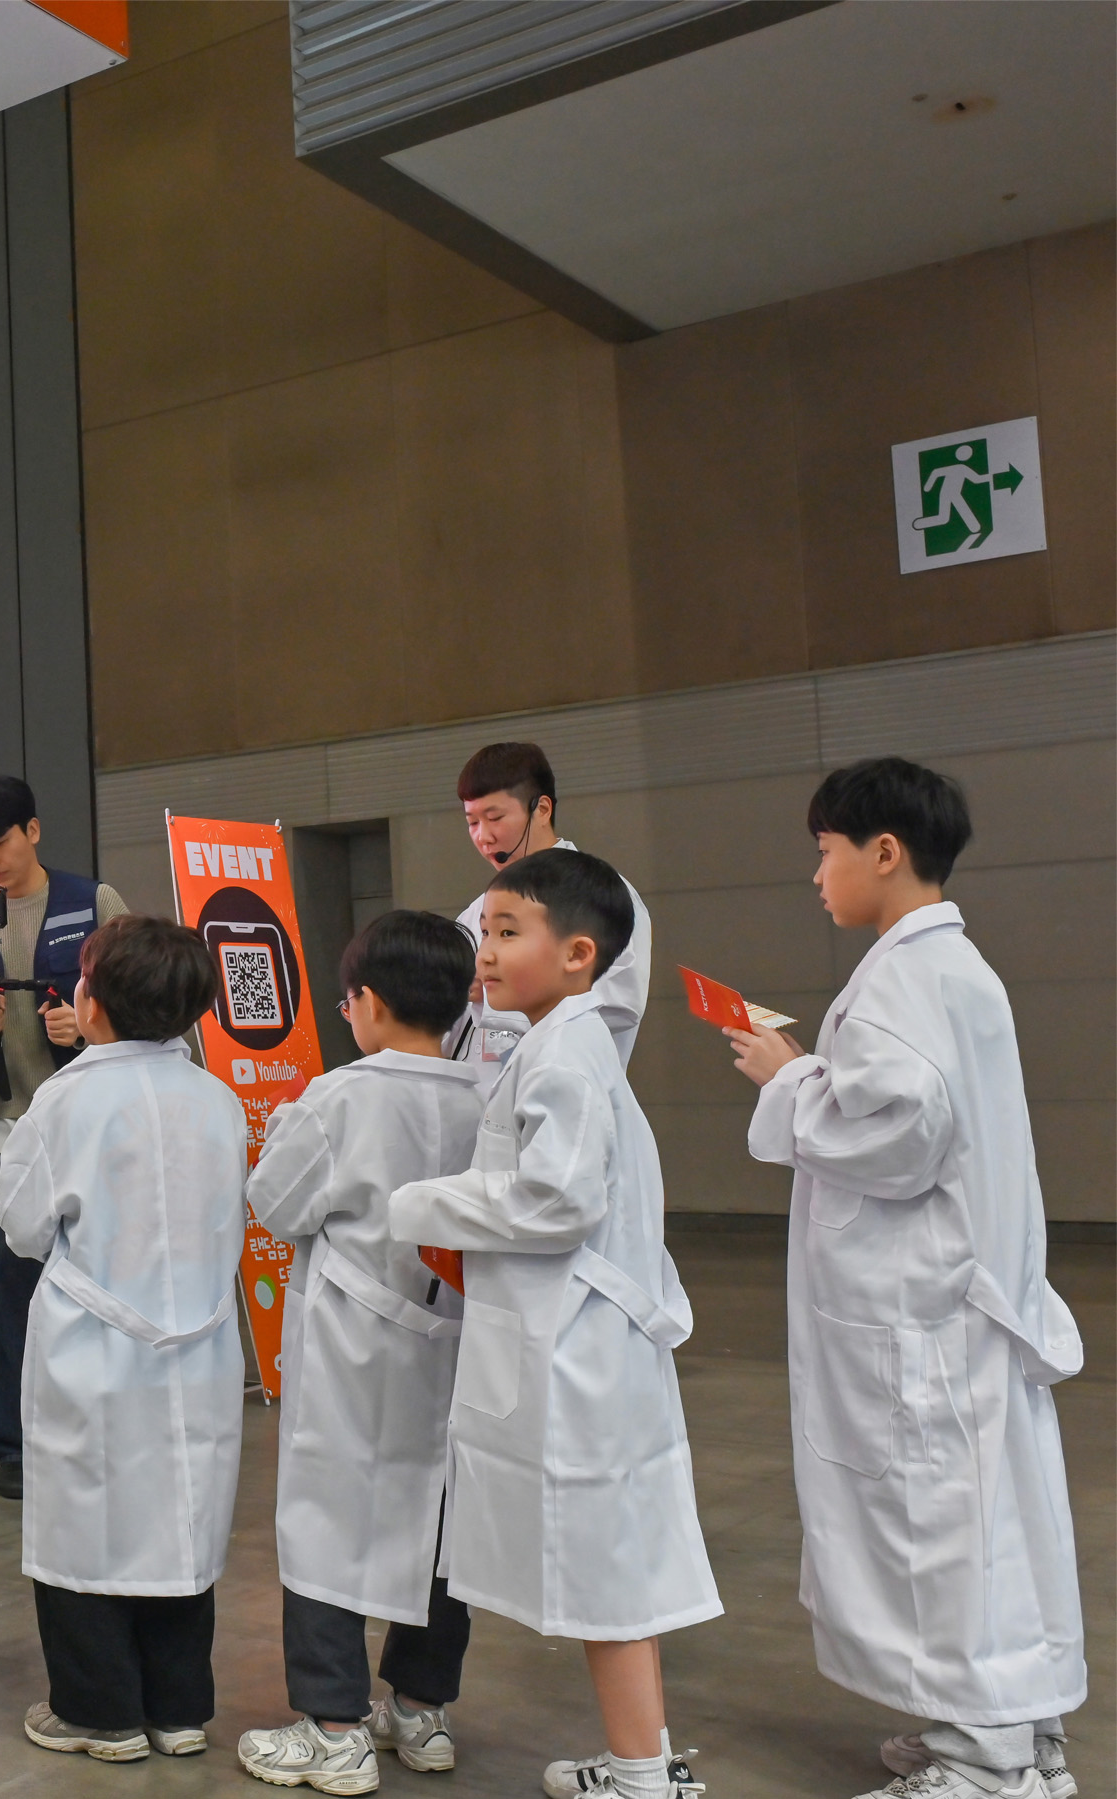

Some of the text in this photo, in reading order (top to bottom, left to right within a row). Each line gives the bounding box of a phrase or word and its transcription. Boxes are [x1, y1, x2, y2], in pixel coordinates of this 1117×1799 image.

[185, 841, 273, 881] EVENT
[256, 1060, 297, 1082] YouTube
[240, 1097, 271, 1122] 건설
[247, 1125, 267, 1148] 튜브
[249, 1236, 296, 1261] 랜덤뽑
